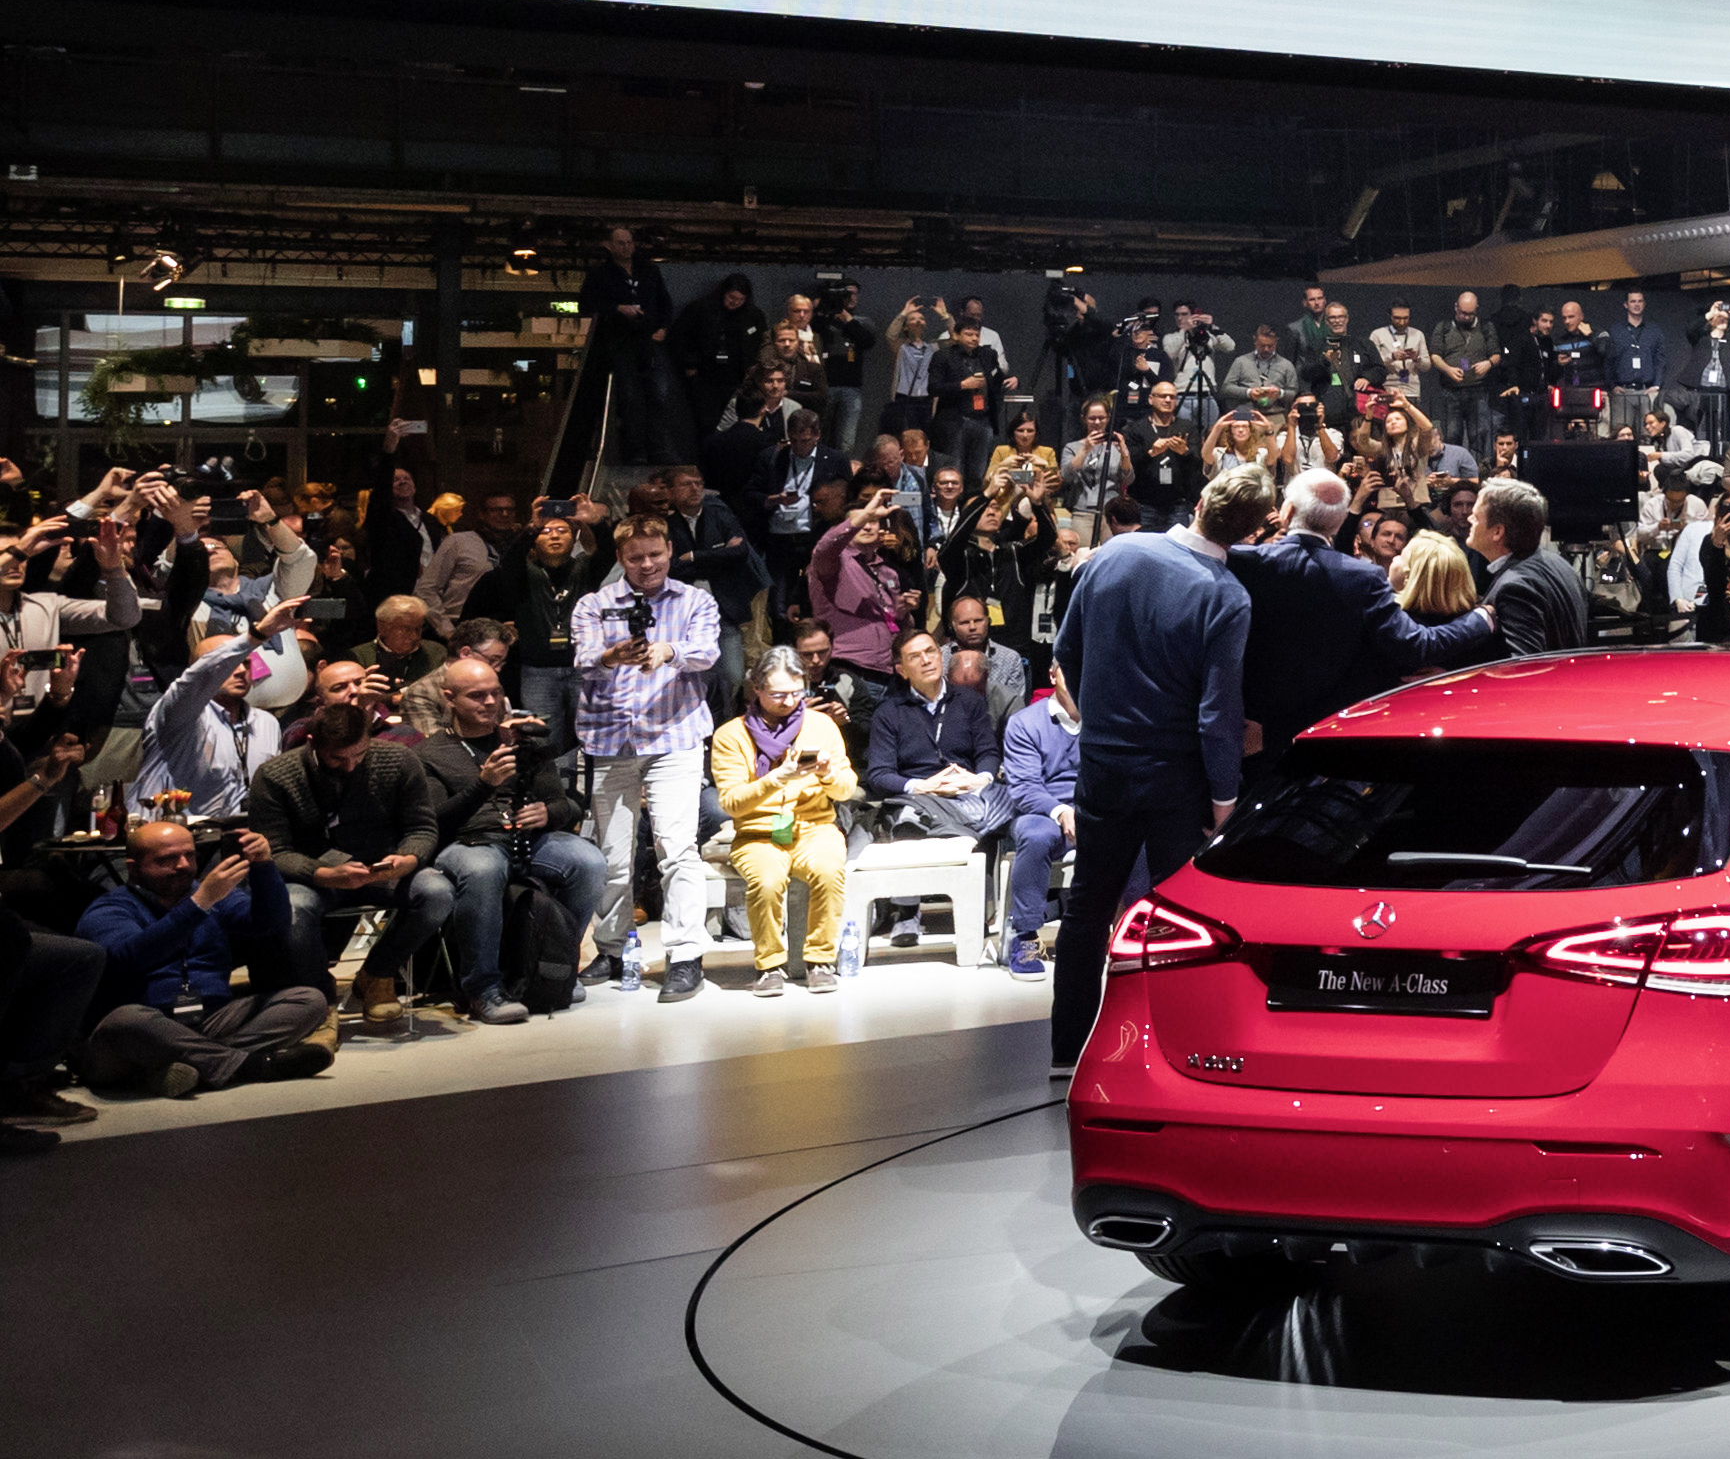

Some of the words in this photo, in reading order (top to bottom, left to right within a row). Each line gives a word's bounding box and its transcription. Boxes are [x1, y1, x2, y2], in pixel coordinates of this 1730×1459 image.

[1318, 970, 1346, 990] The
[1350, 971, 1385, 991] New
[1388, 973, 1449, 994] A-Class
